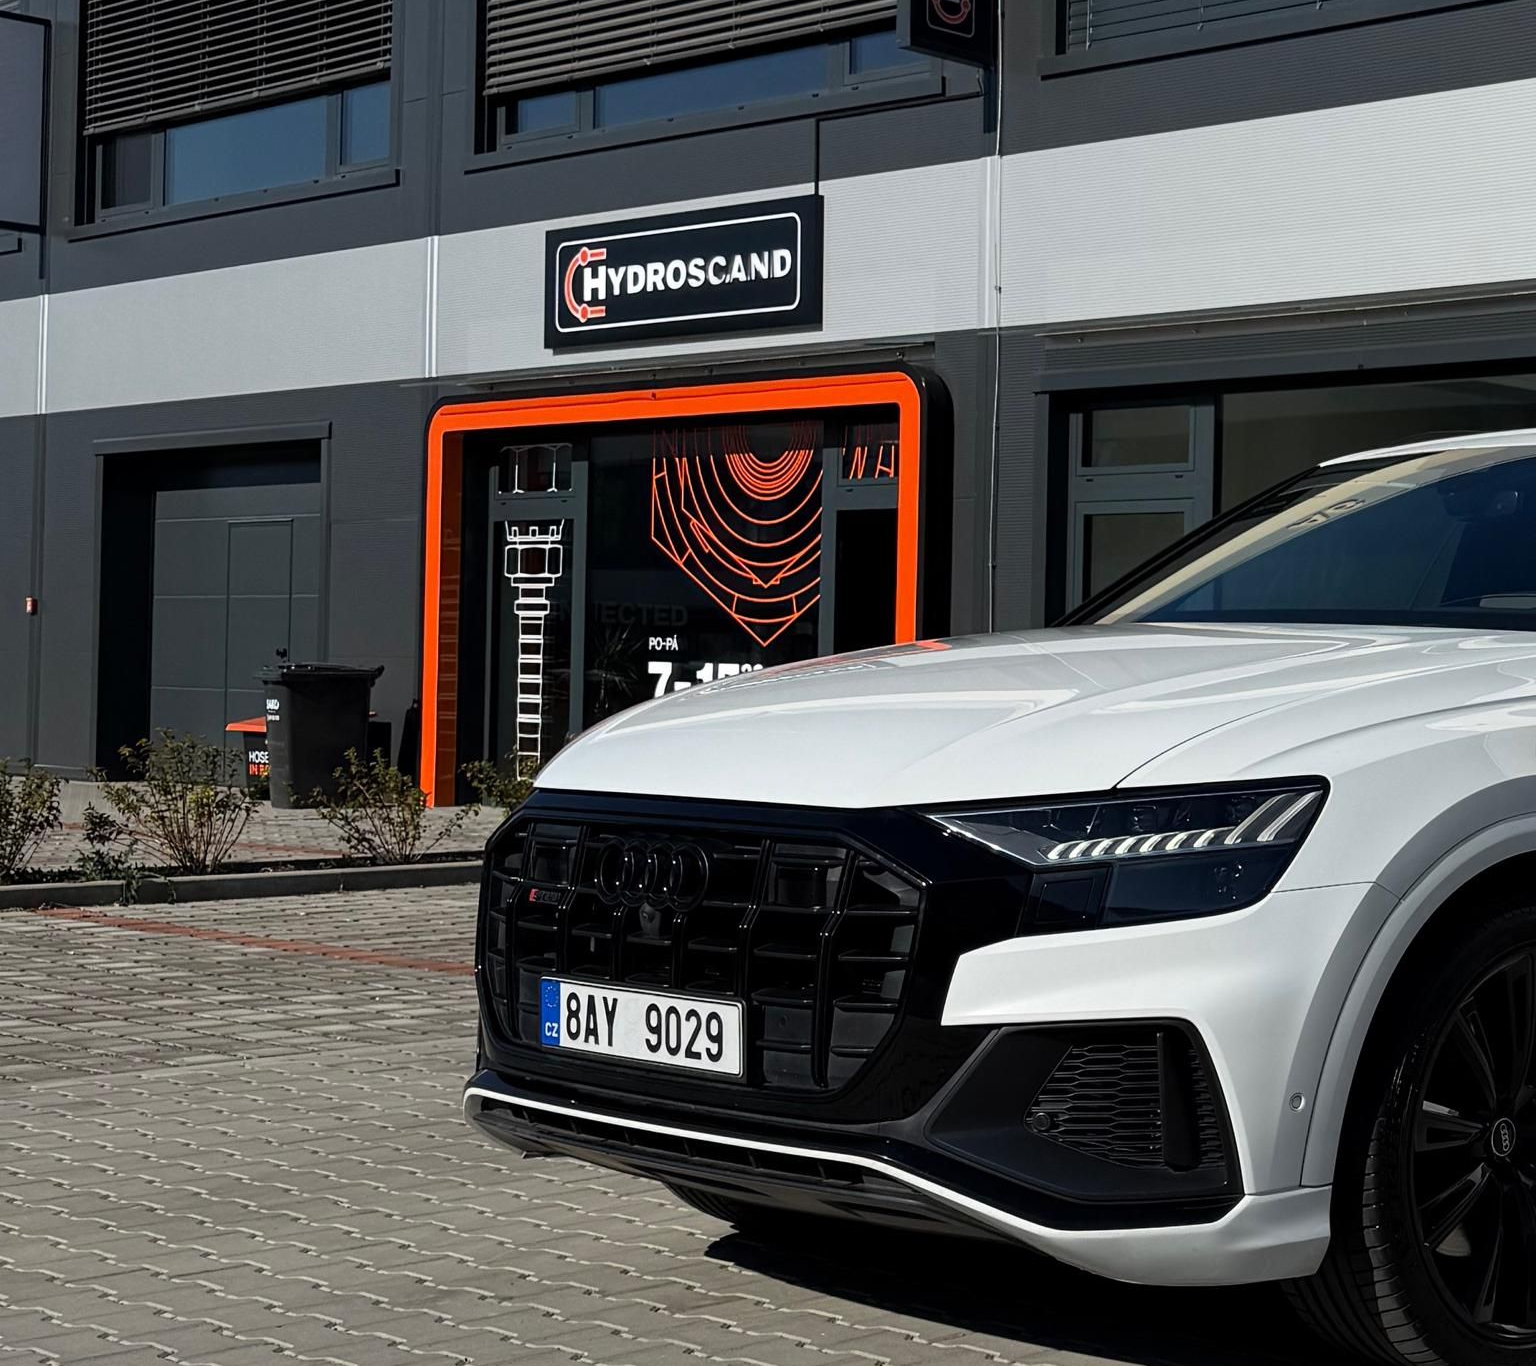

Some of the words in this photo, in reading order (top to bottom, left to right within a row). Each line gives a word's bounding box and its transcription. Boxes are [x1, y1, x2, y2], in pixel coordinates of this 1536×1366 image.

[583, 248, 792, 302] HYDROSCAND
[648, 635, 679, 651] PO-PÁ
[545, 1022, 559, 1037] CZ
[566, 992, 618, 1047] 8AY
[645, 1003, 723, 1062] 9029
